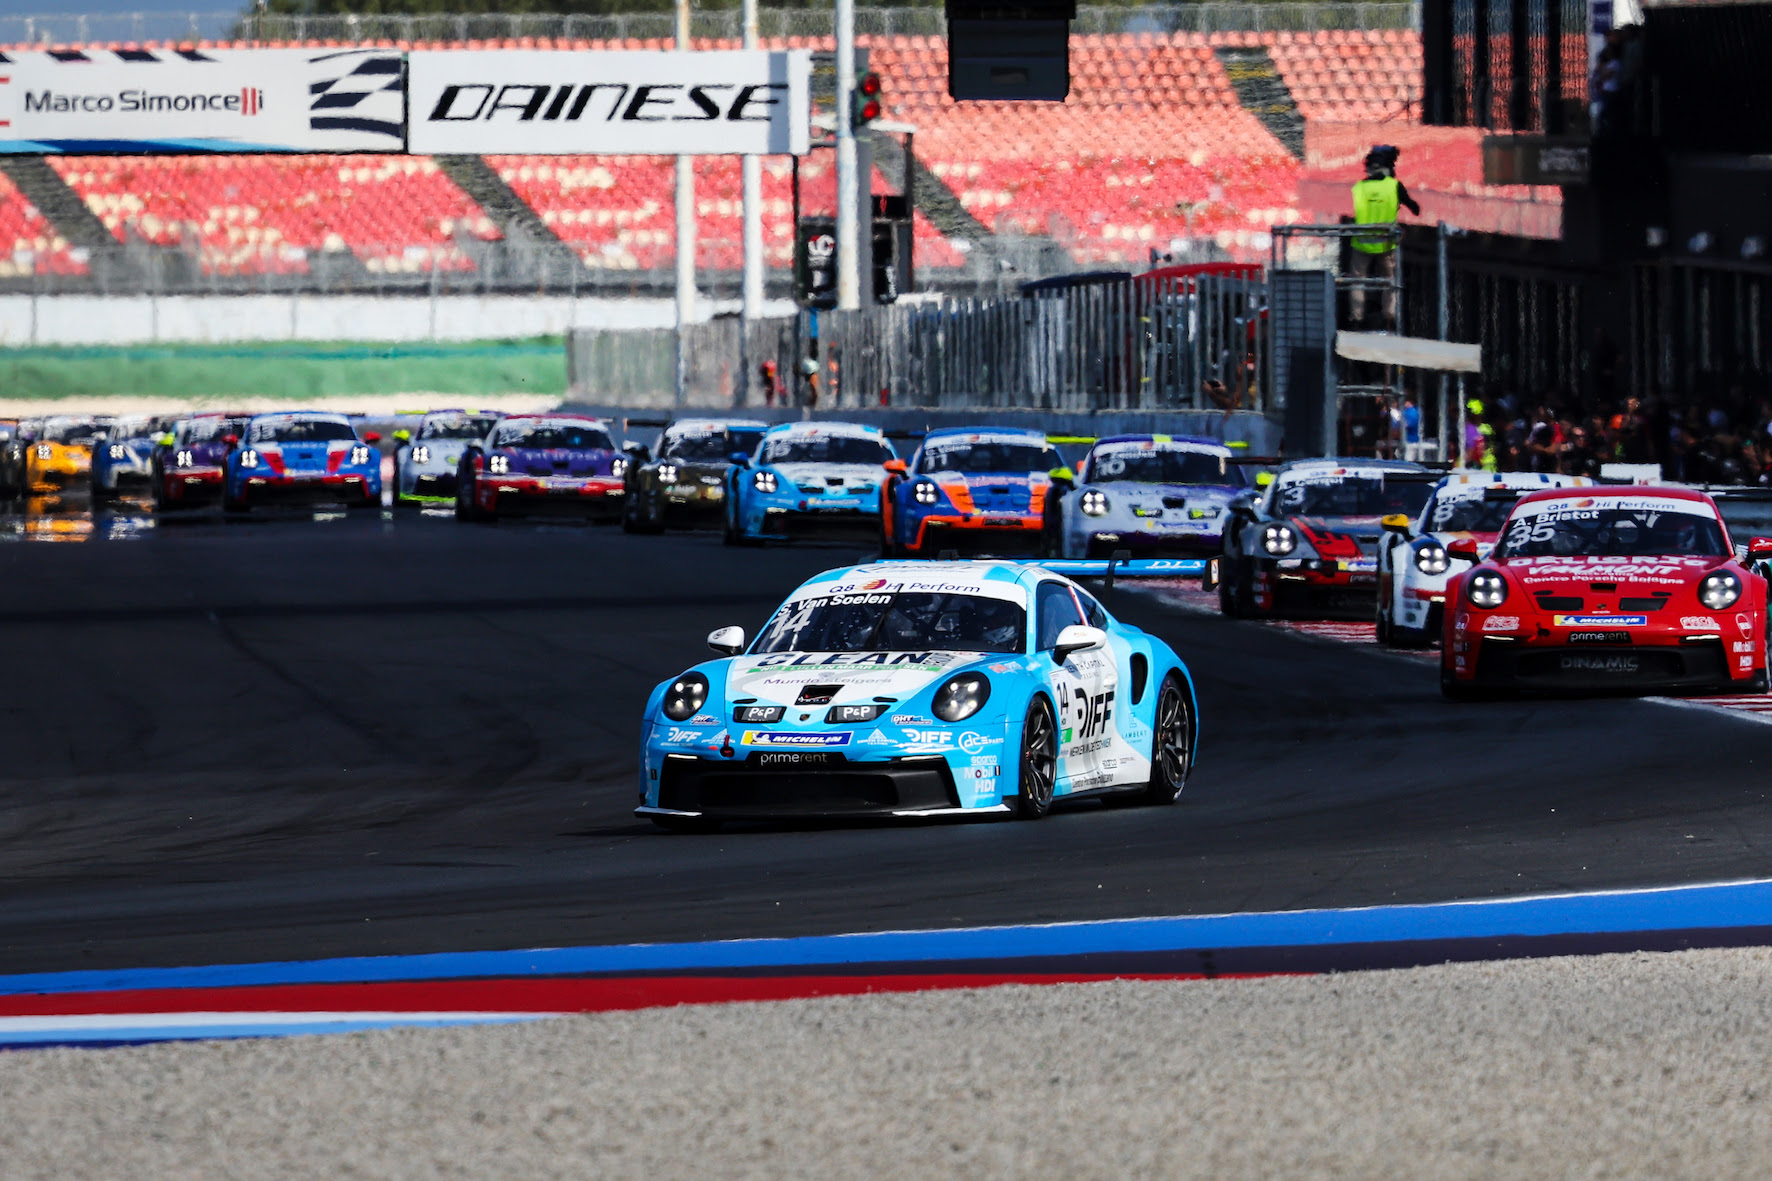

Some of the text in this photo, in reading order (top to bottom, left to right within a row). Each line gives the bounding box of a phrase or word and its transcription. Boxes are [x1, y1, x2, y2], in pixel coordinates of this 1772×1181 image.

[25, 87, 264, 115] Marco Simoncelli
[428, 84, 789, 121] DAINESE
[1433, 503, 1455, 523] 8
[1547, 502, 1569, 511] Q8
[1619, 501, 1676, 510] Perform
[1513, 510, 1600, 528] A. Bristot
[1506, 522, 1557, 548] 35
[1523, 576, 1570, 584] Centro
[1572, 575, 1626, 583] Porsche
[829, 584, 856, 594] Q8
[908, 581, 981, 593] Perform
[777, 593, 892, 618] S. Van Soelen
[769, 606, 811, 640] 14
[1570, 632, 1628, 642] primerent
[757, 651, 933, 667] CLEAN
[1561, 657, 1640, 669] DINAMIC
[1057, 681, 1069, 716] 14
[748, 707, 775, 718] P&P
[843, 706, 871, 719] P&P
[1074, 687, 1115, 739] DIFF
[668, 727, 702, 742] DIFF
[773, 734, 843, 744] MICHELIN
[901, 728, 953, 743] DIFF
[1121, 730, 1148, 740] LAMBERT
[760, 753, 828, 766] primerent
[970, 755, 998, 765] sparco
[964, 765, 994, 779] Mobil
[975, 779, 996, 793] HDI
